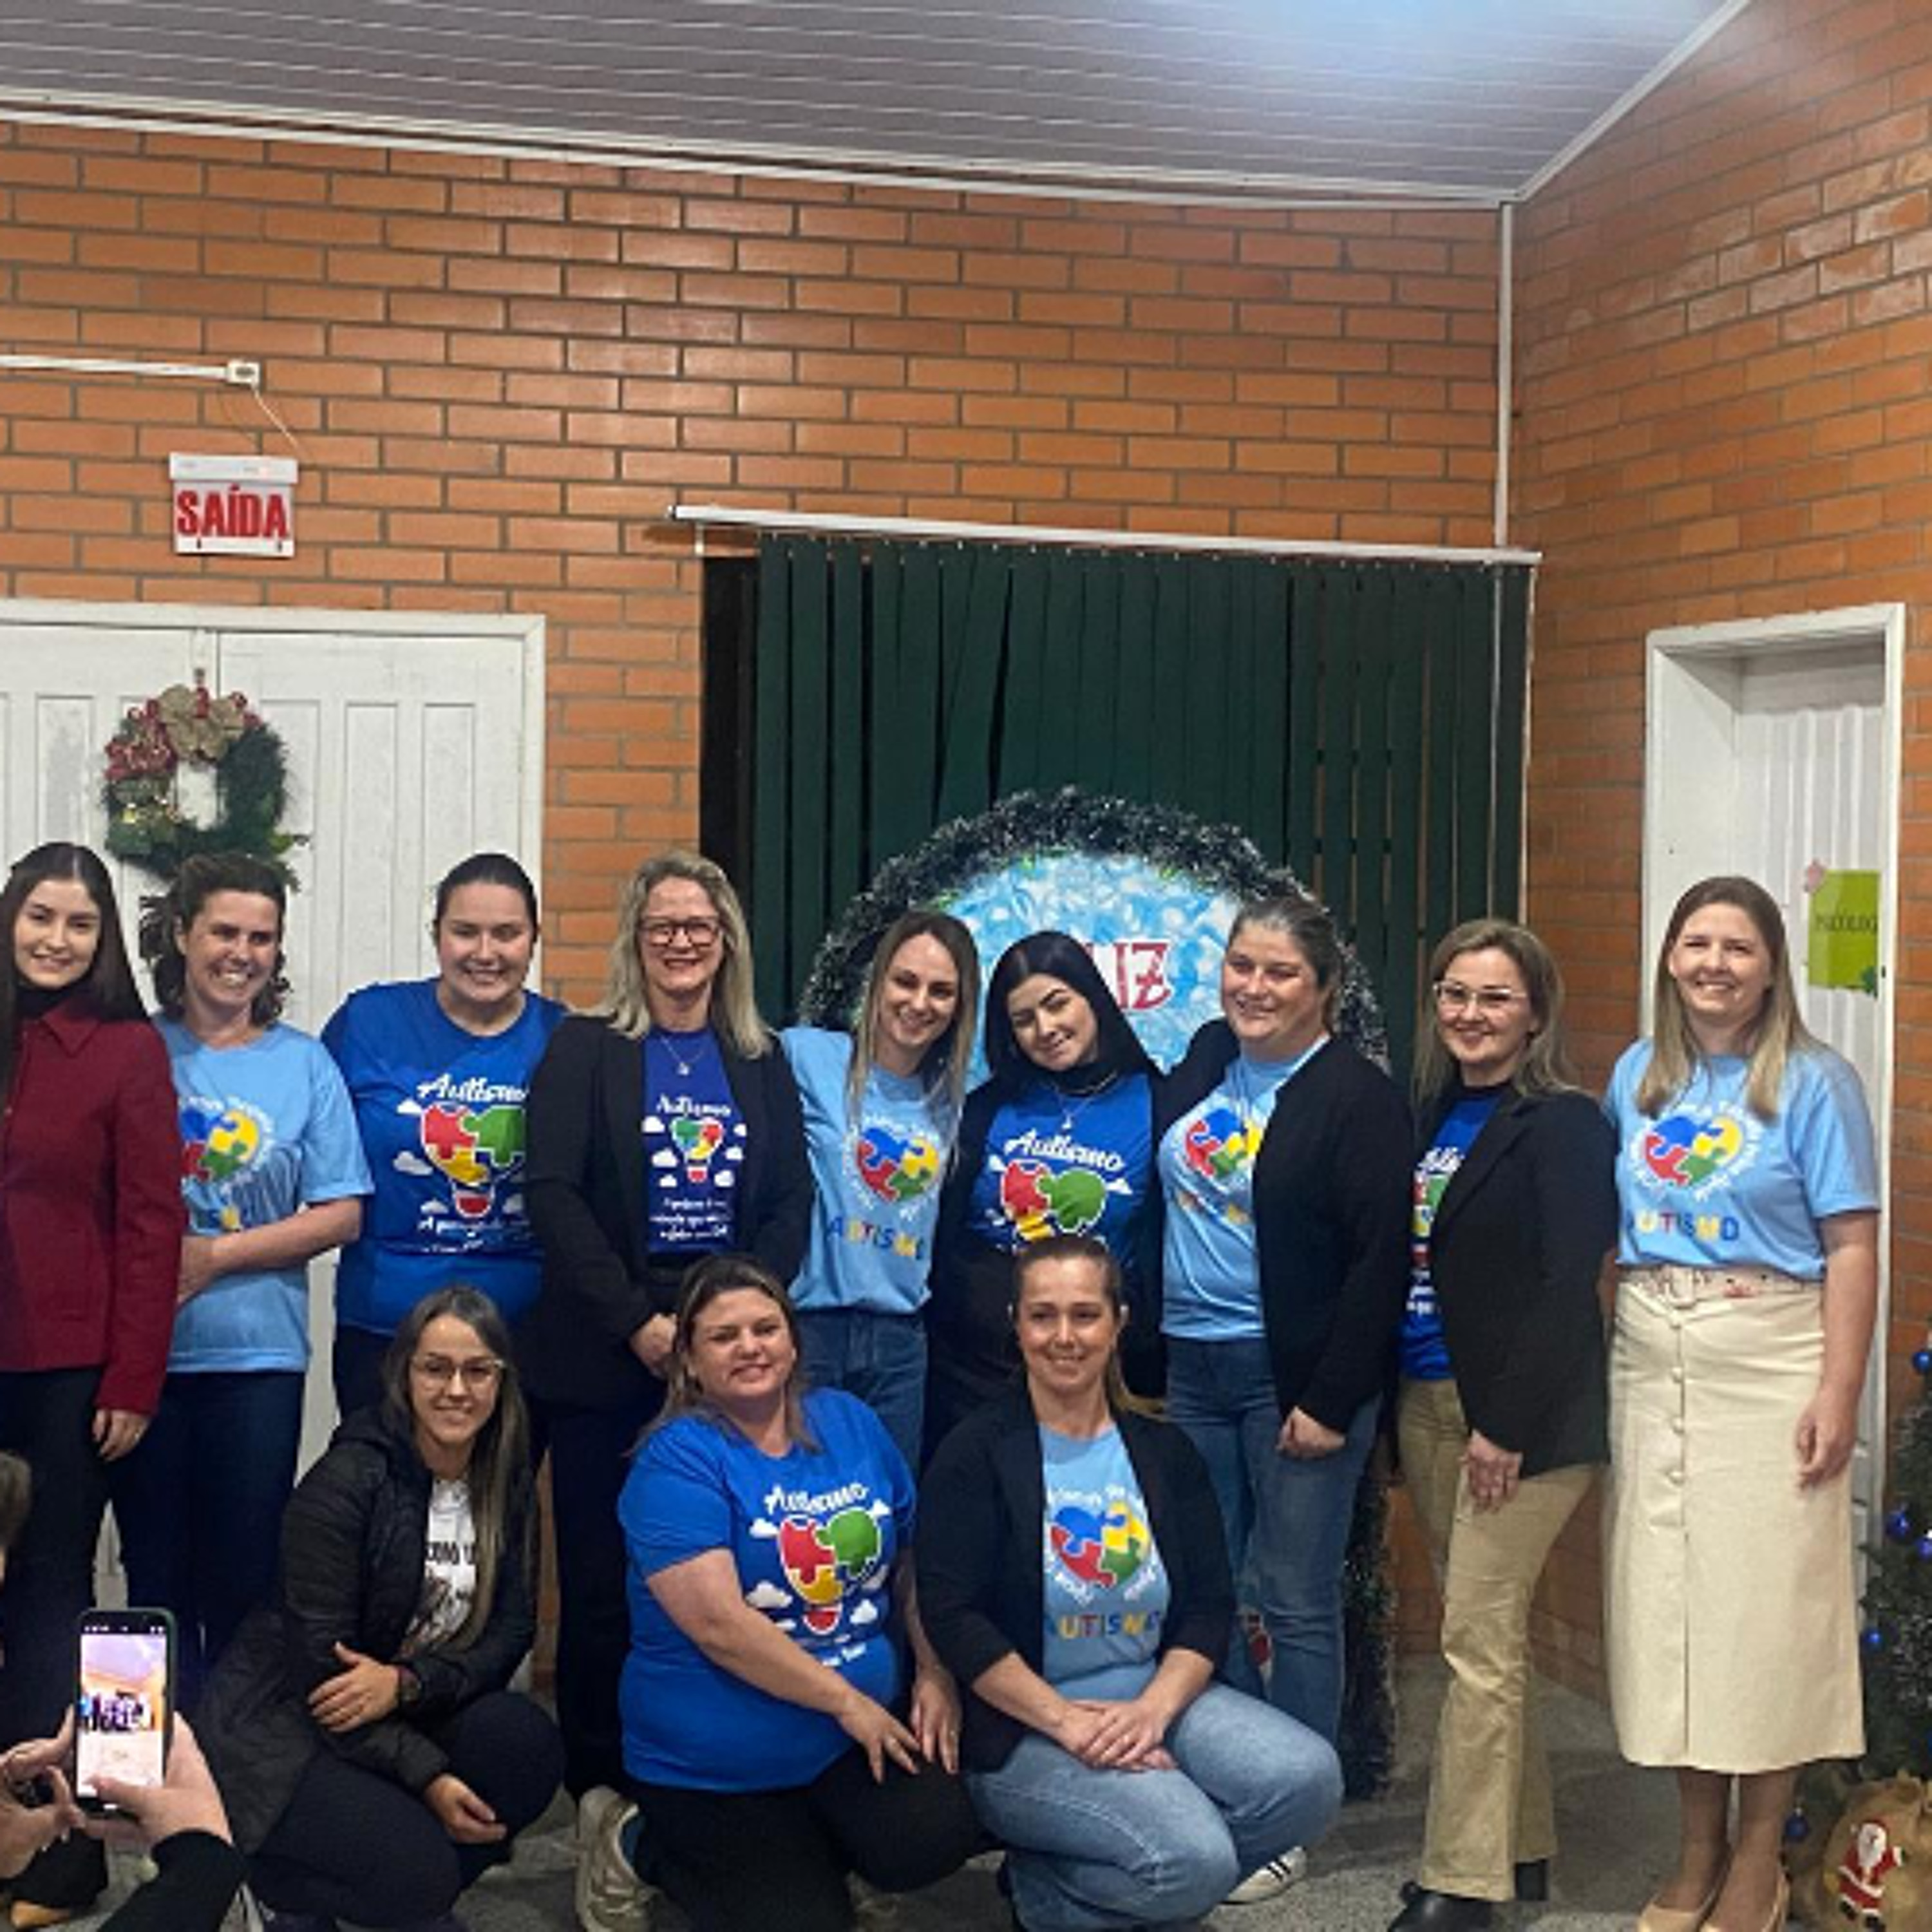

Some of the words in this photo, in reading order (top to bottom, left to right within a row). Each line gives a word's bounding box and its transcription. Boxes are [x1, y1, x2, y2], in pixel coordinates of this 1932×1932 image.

[176, 484, 287, 538] SAÍDA
[1084, 942, 1171, 1009] IZ
[1003, 1128, 1126, 1171] Autismo
[764, 1483, 867, 1515] Autismo
